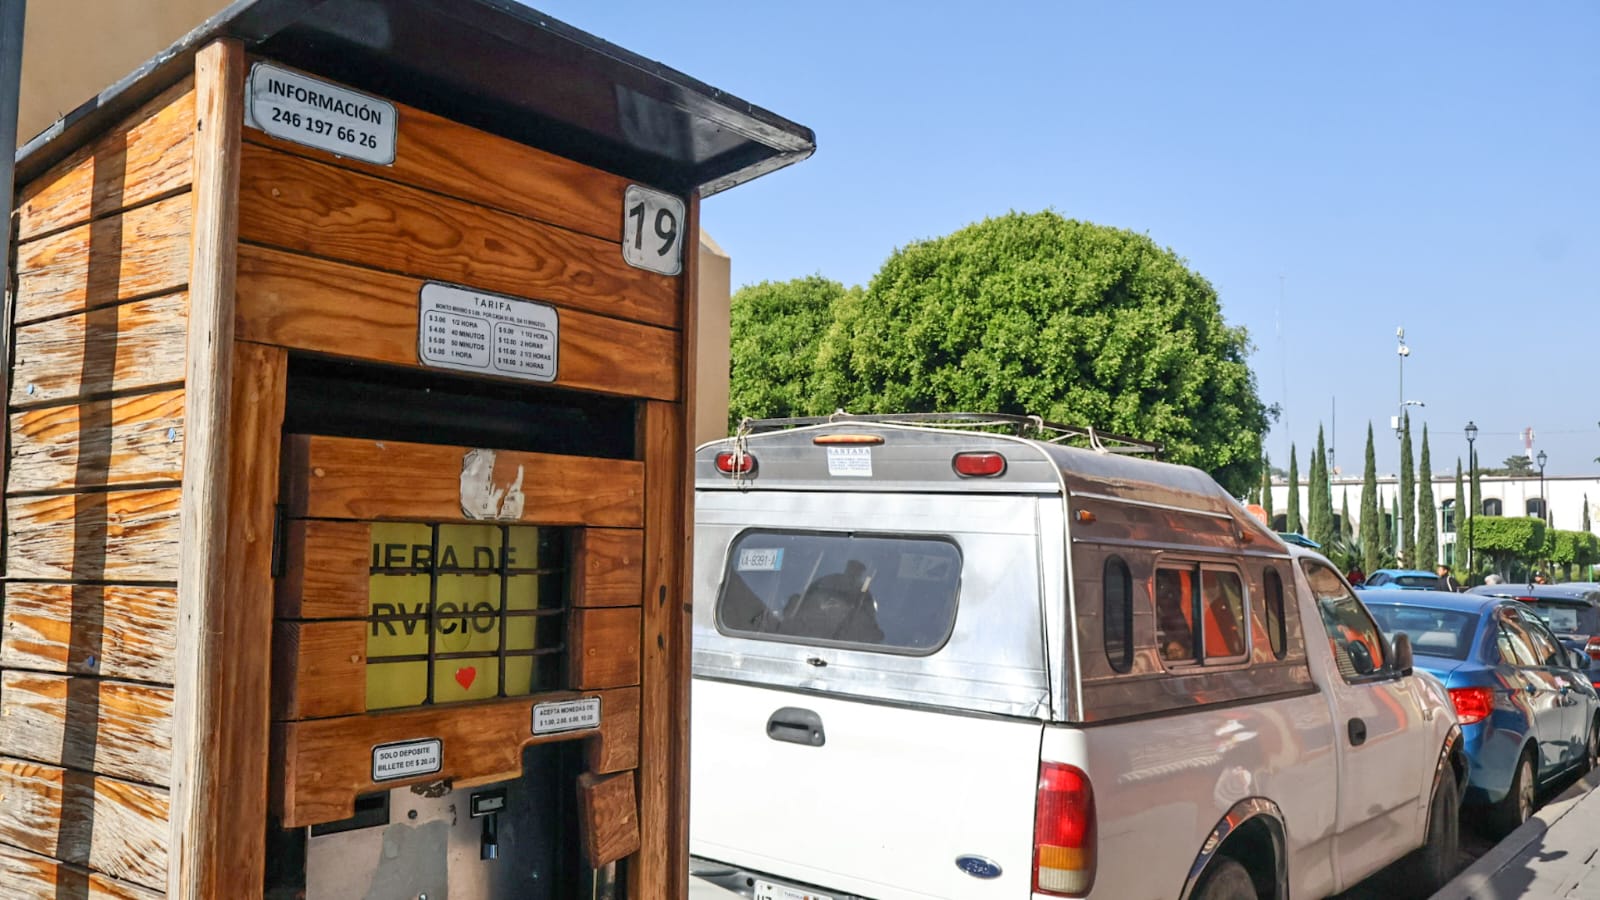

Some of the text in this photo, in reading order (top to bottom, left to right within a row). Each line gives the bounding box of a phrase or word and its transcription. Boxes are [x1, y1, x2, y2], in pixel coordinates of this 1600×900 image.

[268, 78, 381, 125] INFORMACIÓN
[272, 107, 377, 149] 246 197 66 26
[629, 202, 677, 256] 19
[474, 296, 512, 312] TARIFA
[452, 318, 460, 326] 1/2
[461, 320, 478, 328] HORA
[433, 326, 446, 334] 4.00
[459, 330, 485, 340] MINUTOS
[459, 340, 485, 351] MINUTOS
[524, 341, 543, 349] HORAS
[455, 351, 473, 359] HORA
[533, 352, 551, 361] HORAS
[525, 361, 544, 369] HORAS
[540, 708, 560, 716] ACEPTA
[380, 747, 430, 760] SOLO DEPOSITE
[377, 761, 404, 772] BILLETE
